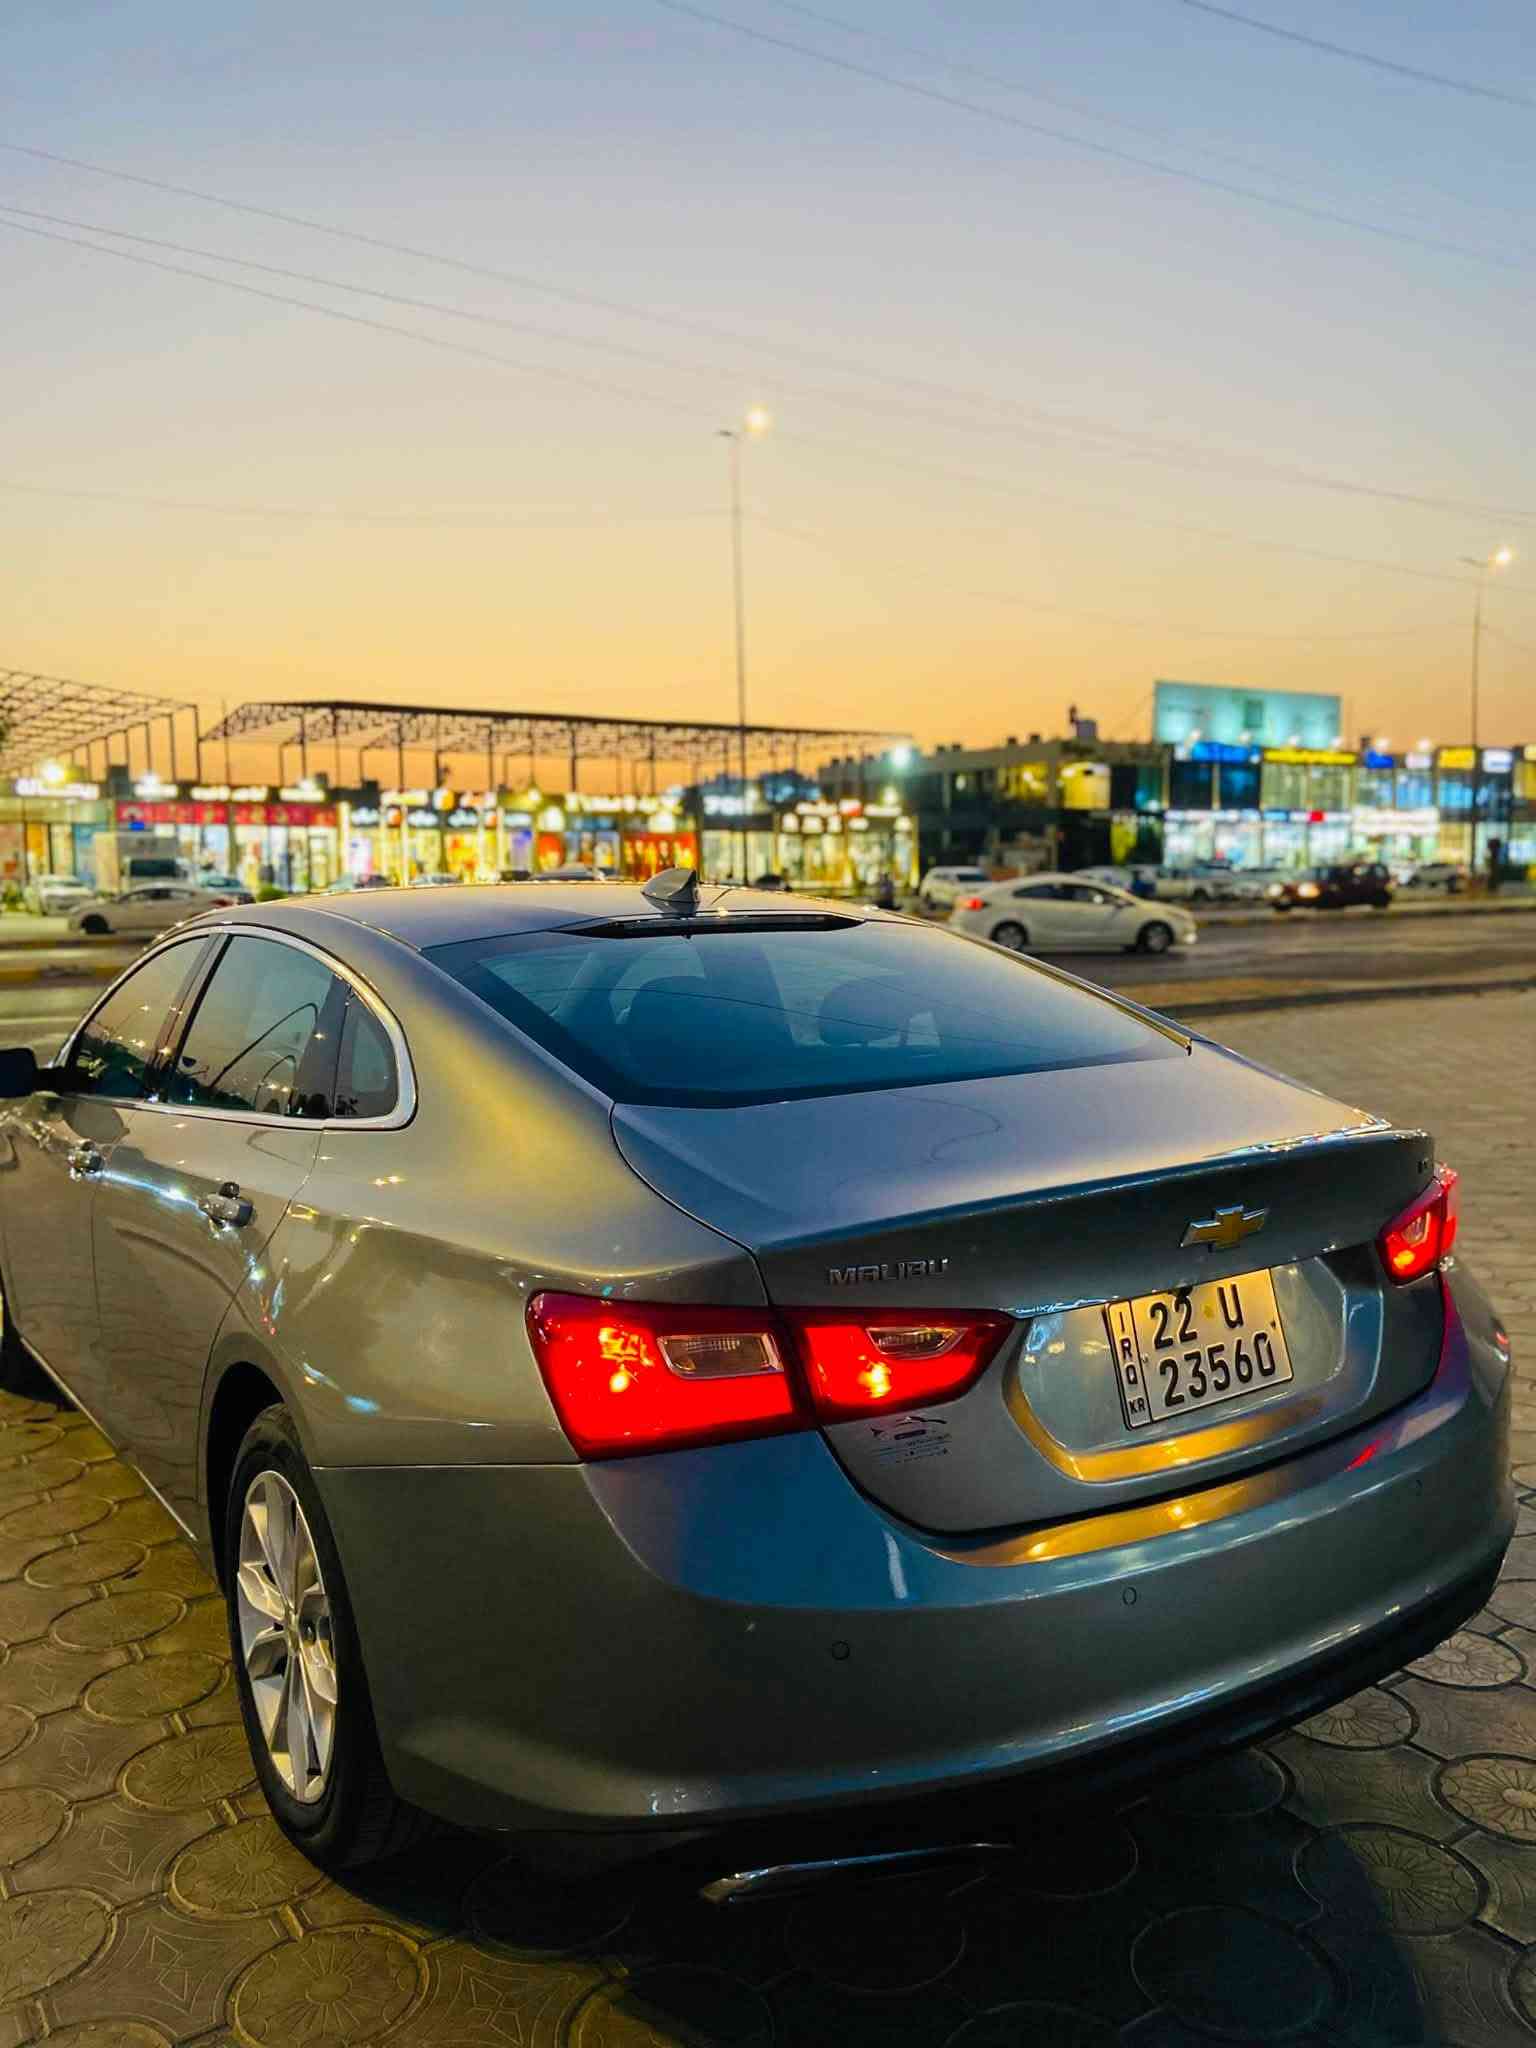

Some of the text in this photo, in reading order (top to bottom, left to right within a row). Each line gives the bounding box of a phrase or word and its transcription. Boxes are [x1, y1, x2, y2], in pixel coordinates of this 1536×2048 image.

[828, 1258, 949, 1283] MALIBU
[1150, 1283, 1244, 1350] 22 U
[1158, 1331, 1277, 1408] 23560
[1128, 1397, 1146, 1414] KR
